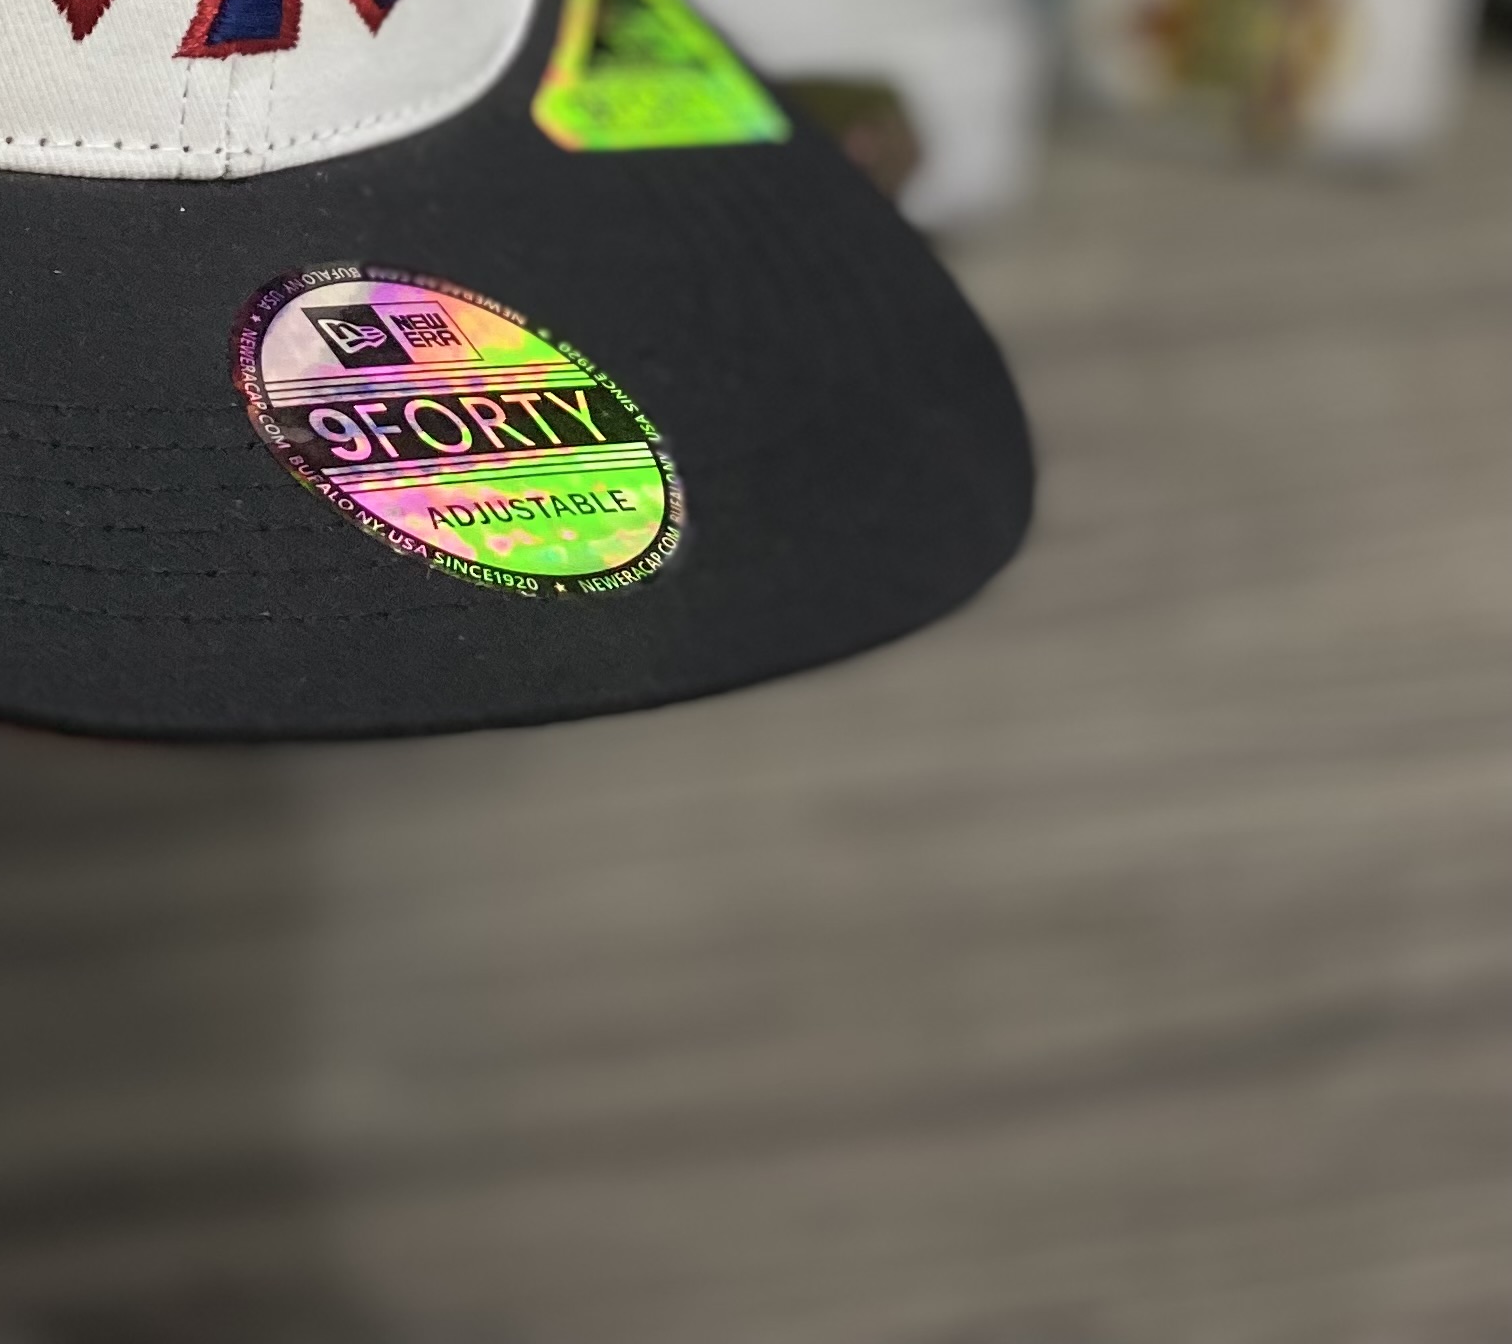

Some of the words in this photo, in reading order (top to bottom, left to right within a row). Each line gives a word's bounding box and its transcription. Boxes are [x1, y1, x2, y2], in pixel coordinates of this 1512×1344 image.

[389, 312, 448, 332] NEW
[402, 329, 463, 348] ERA
[307, 390, 607, 461] 9FORTY
[426, 490, 637, 530] ADJUSTABLE
